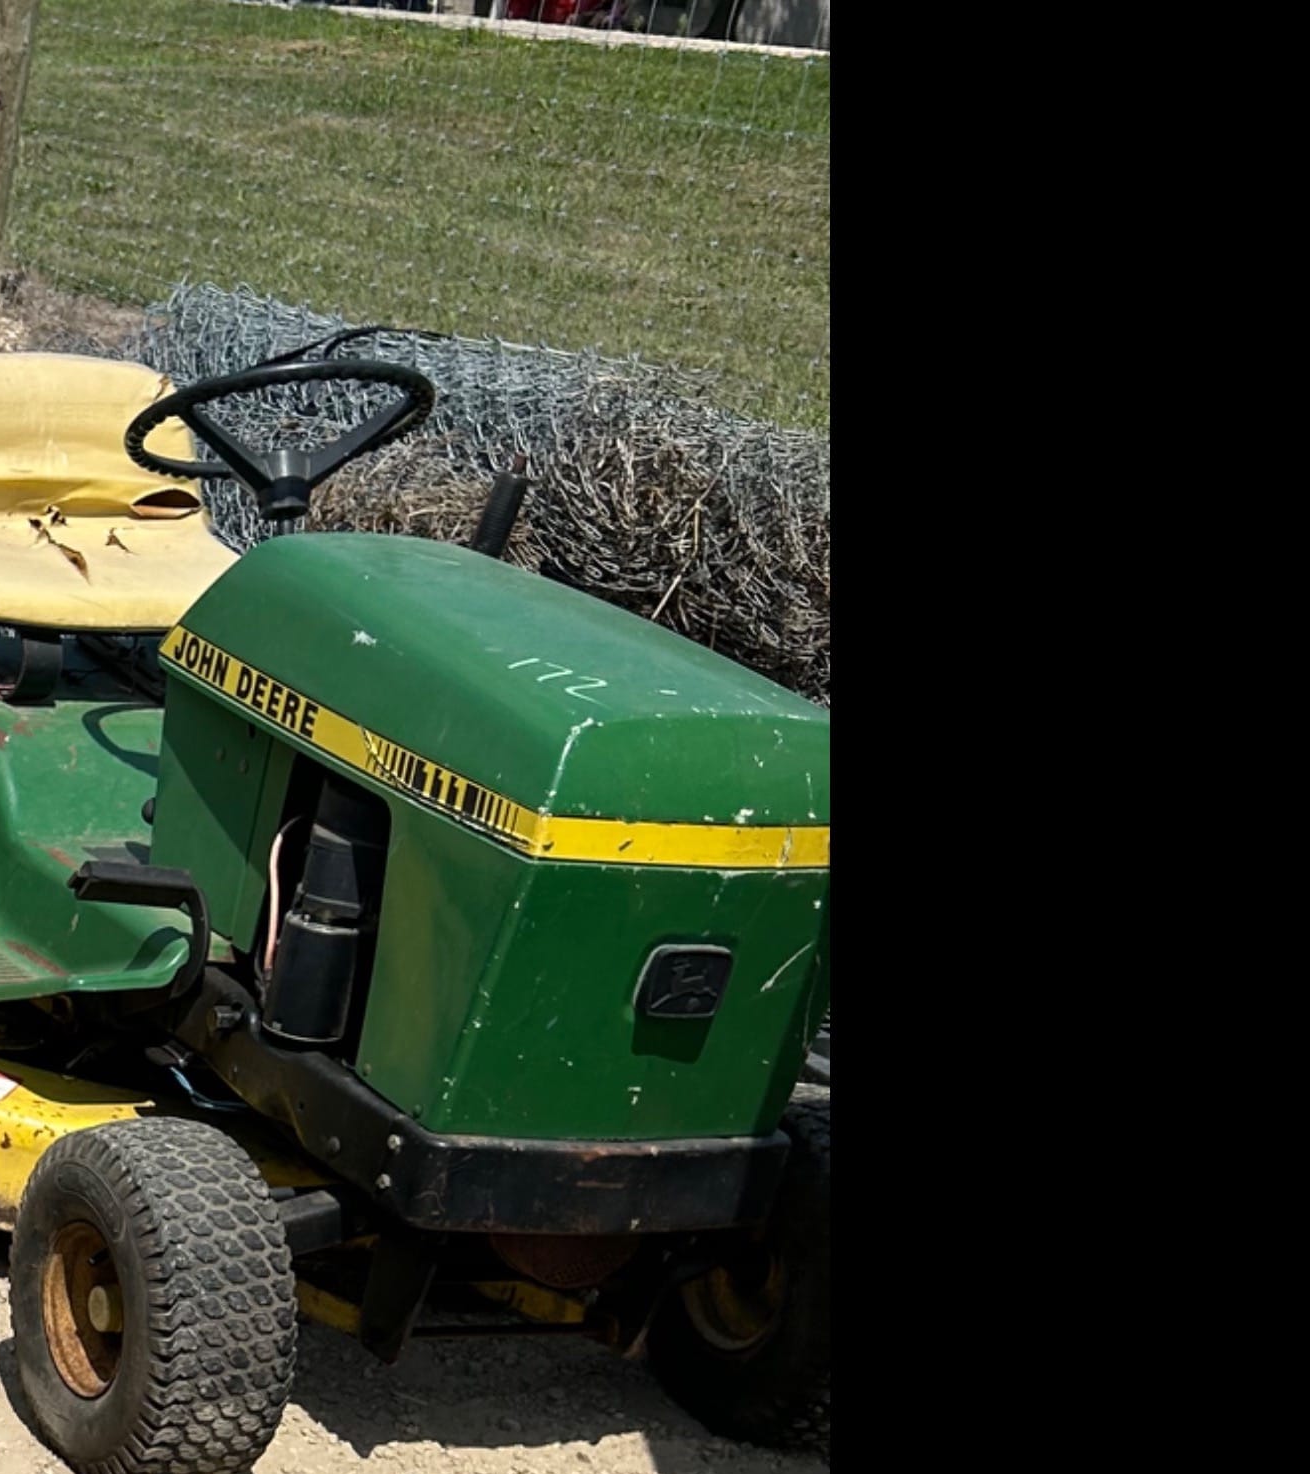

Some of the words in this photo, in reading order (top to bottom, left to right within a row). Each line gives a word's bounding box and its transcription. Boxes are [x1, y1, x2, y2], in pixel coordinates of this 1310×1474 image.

[174, 632, 230, 687] JOHN
[236, 666, 319, 738] DEERE
[507, 658, 612, 709] 172
